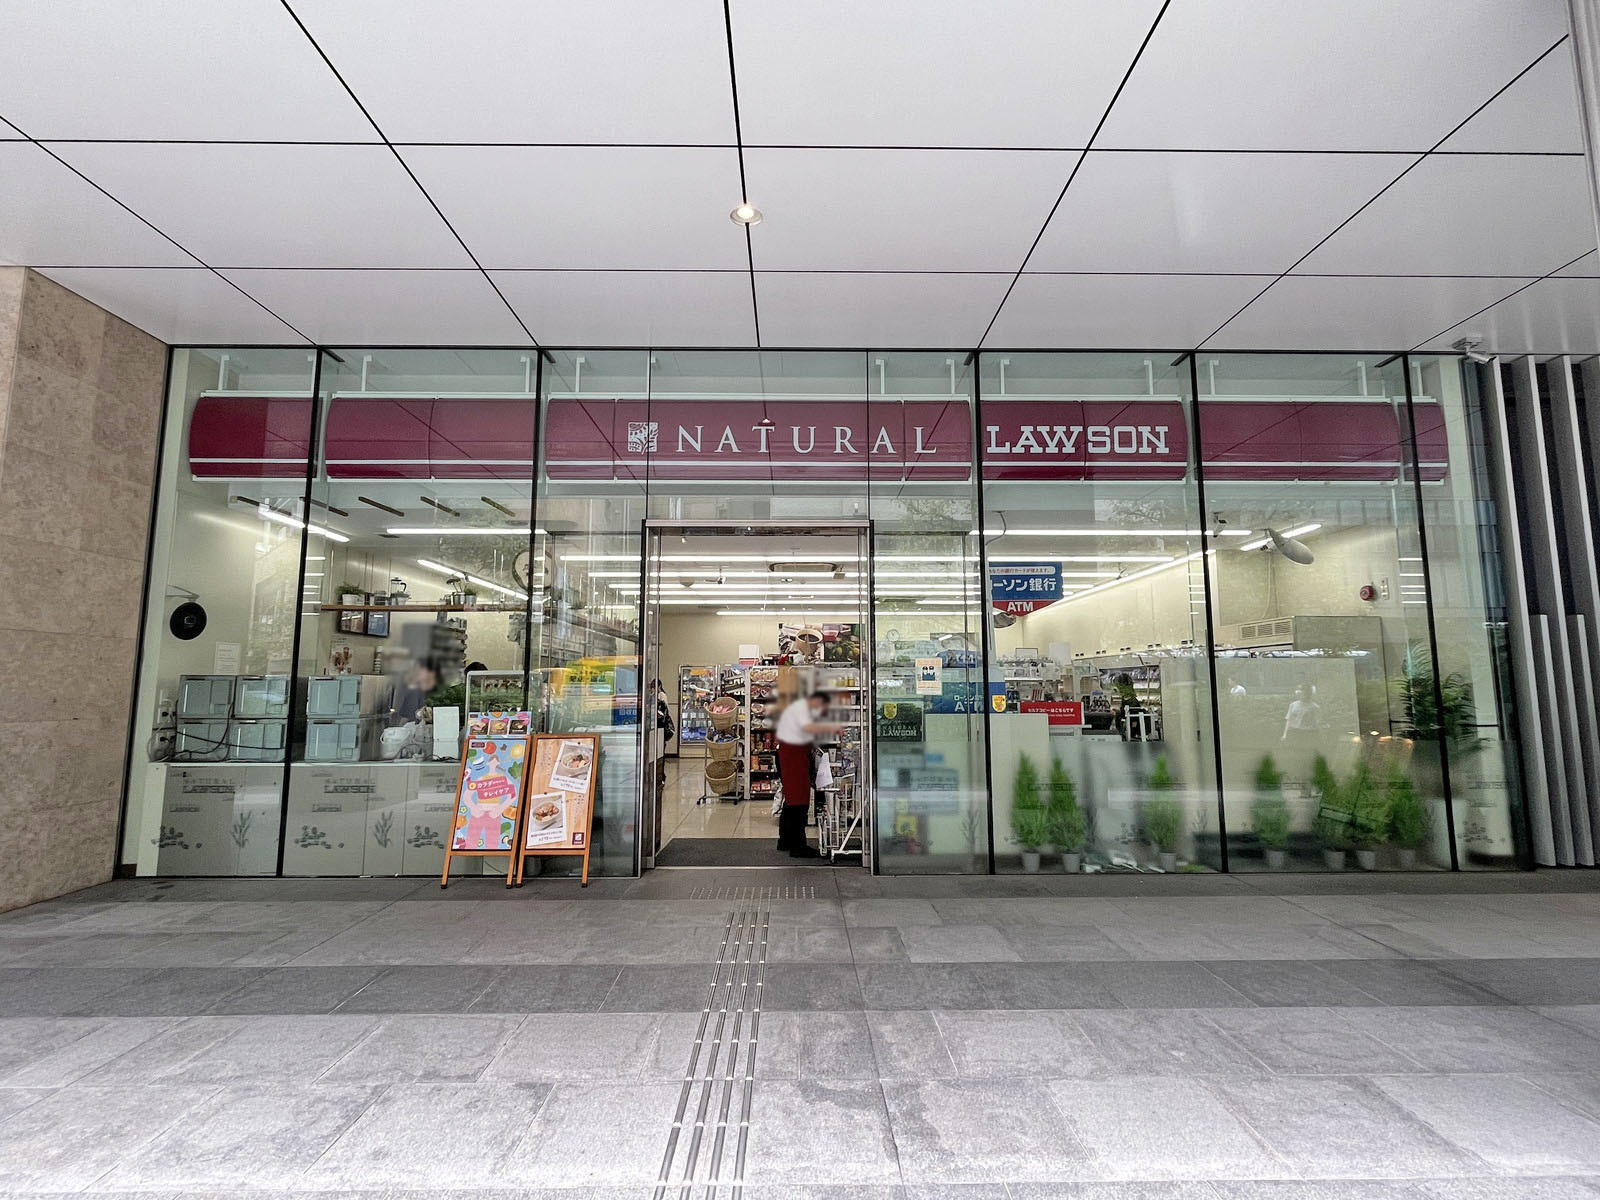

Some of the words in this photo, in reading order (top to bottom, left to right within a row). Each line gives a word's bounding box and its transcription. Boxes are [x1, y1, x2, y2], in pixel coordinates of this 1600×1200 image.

[676, 424, 938, 454] NATURAL
[986, 425, 1170, 455] LAWSON
[990, 577, 1057, 592] ーソン銀行
[1007, 601, 1034, 612] ATM
